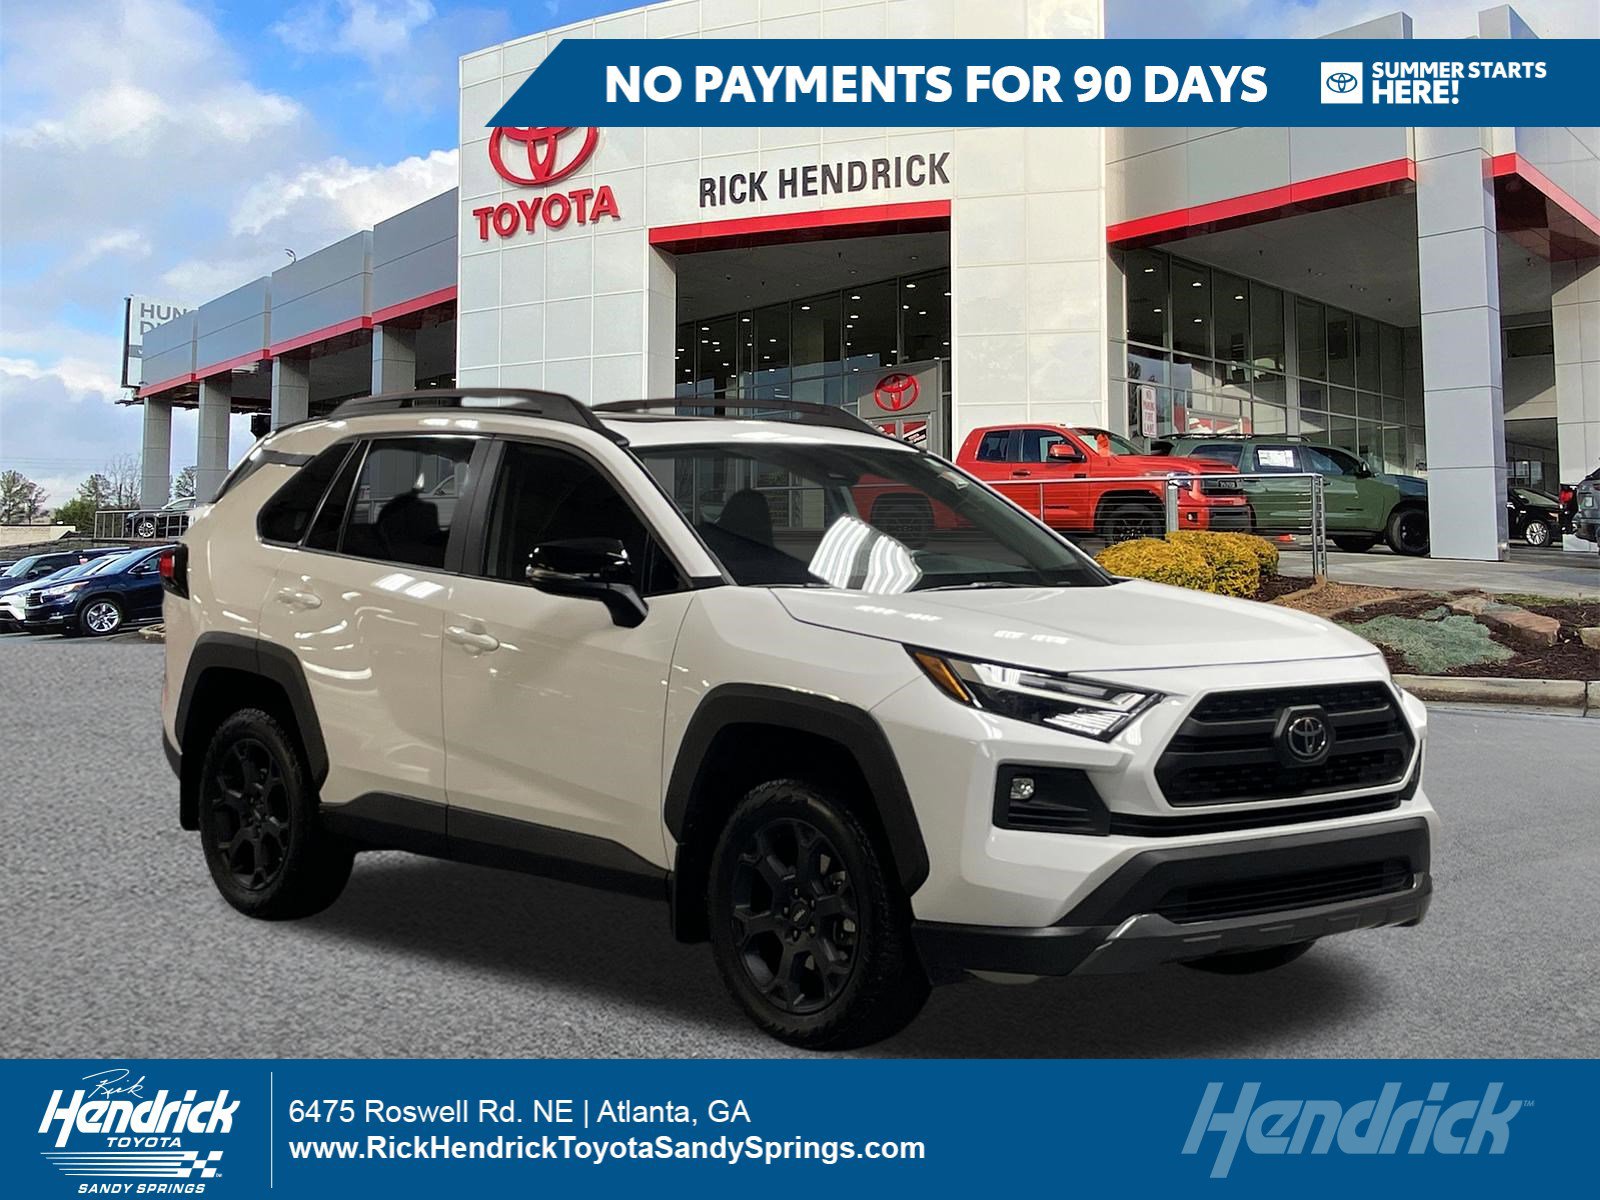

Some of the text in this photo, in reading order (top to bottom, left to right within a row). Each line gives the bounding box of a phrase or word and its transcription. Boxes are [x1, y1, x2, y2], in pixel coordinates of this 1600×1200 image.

[699, 151, 950, 207] RICK HENDRICK
[472, 185, 621, 241] TOYOTA
